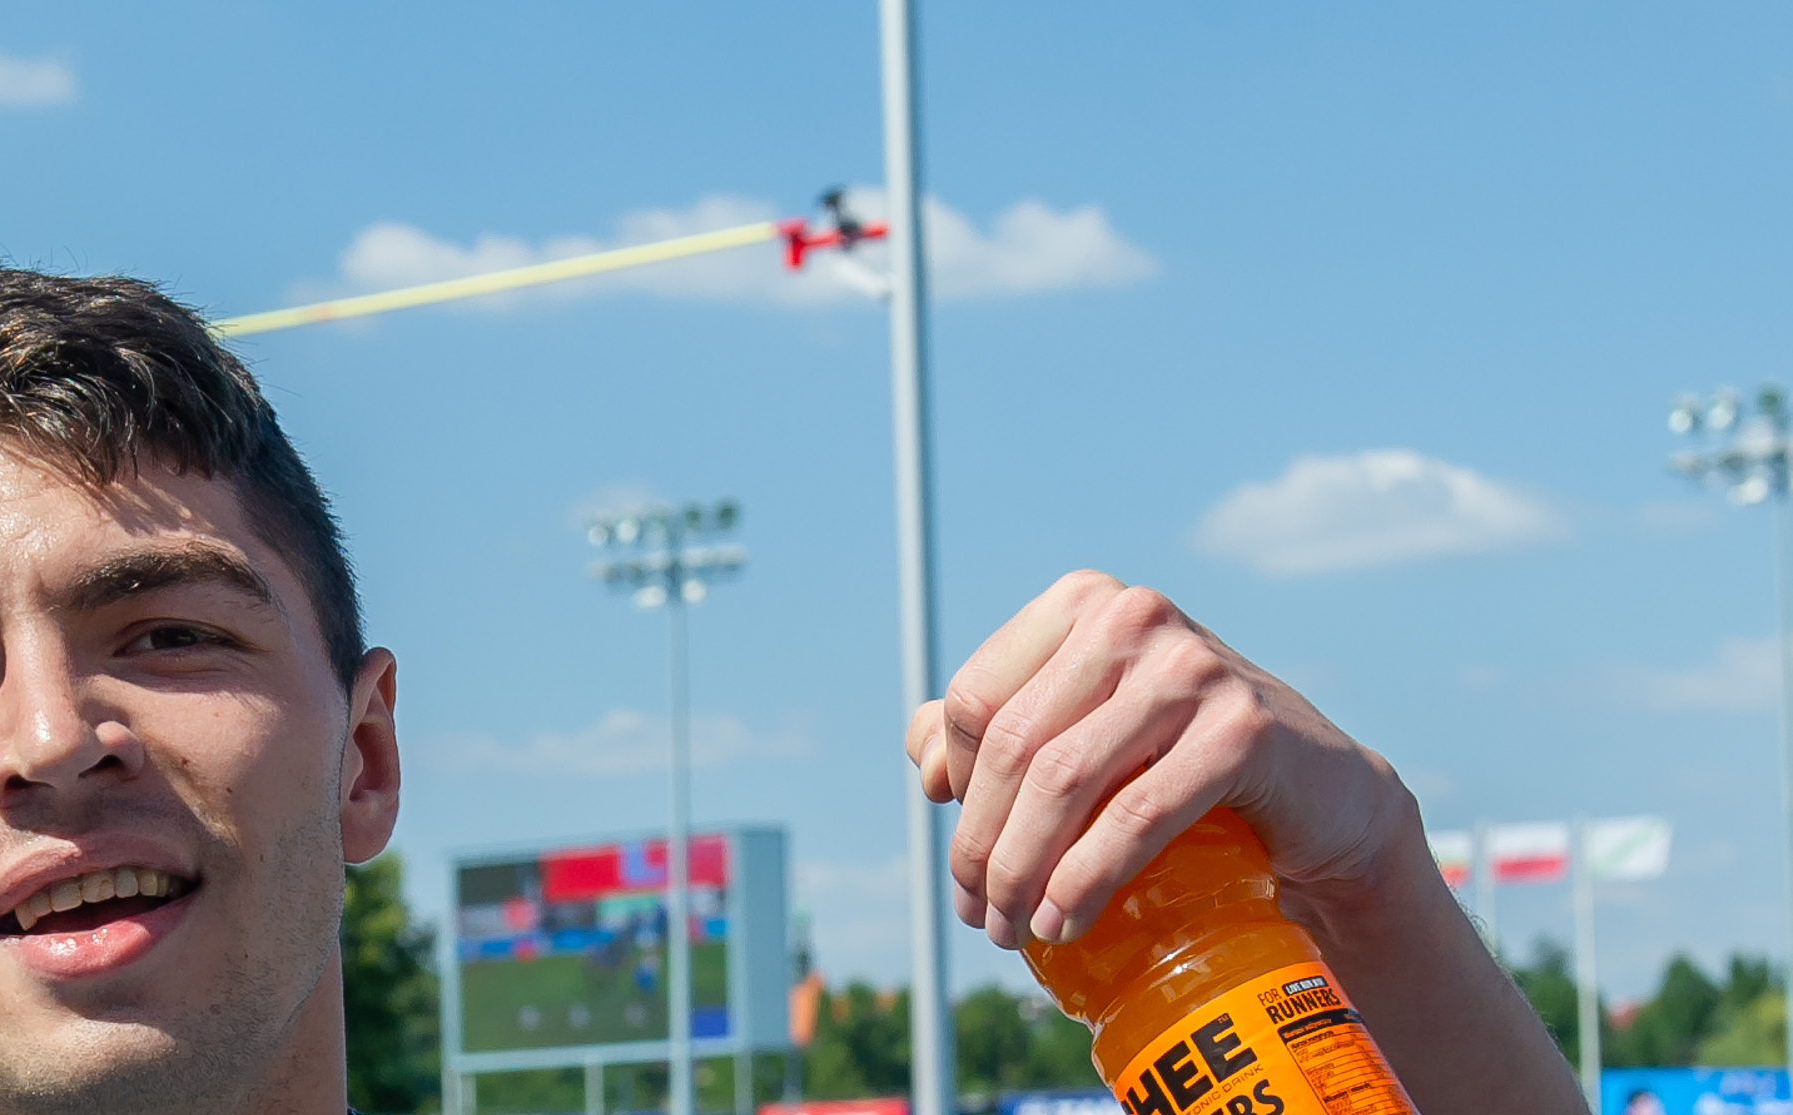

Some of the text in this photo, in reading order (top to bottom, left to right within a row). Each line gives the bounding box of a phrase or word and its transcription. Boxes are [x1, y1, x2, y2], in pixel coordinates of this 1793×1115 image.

[1257, 988, 1282, 1006] FOR
[1266, 988, 1342, 1024] RUNNERS
[1222, 1063, 1265, 1093] DRINK
